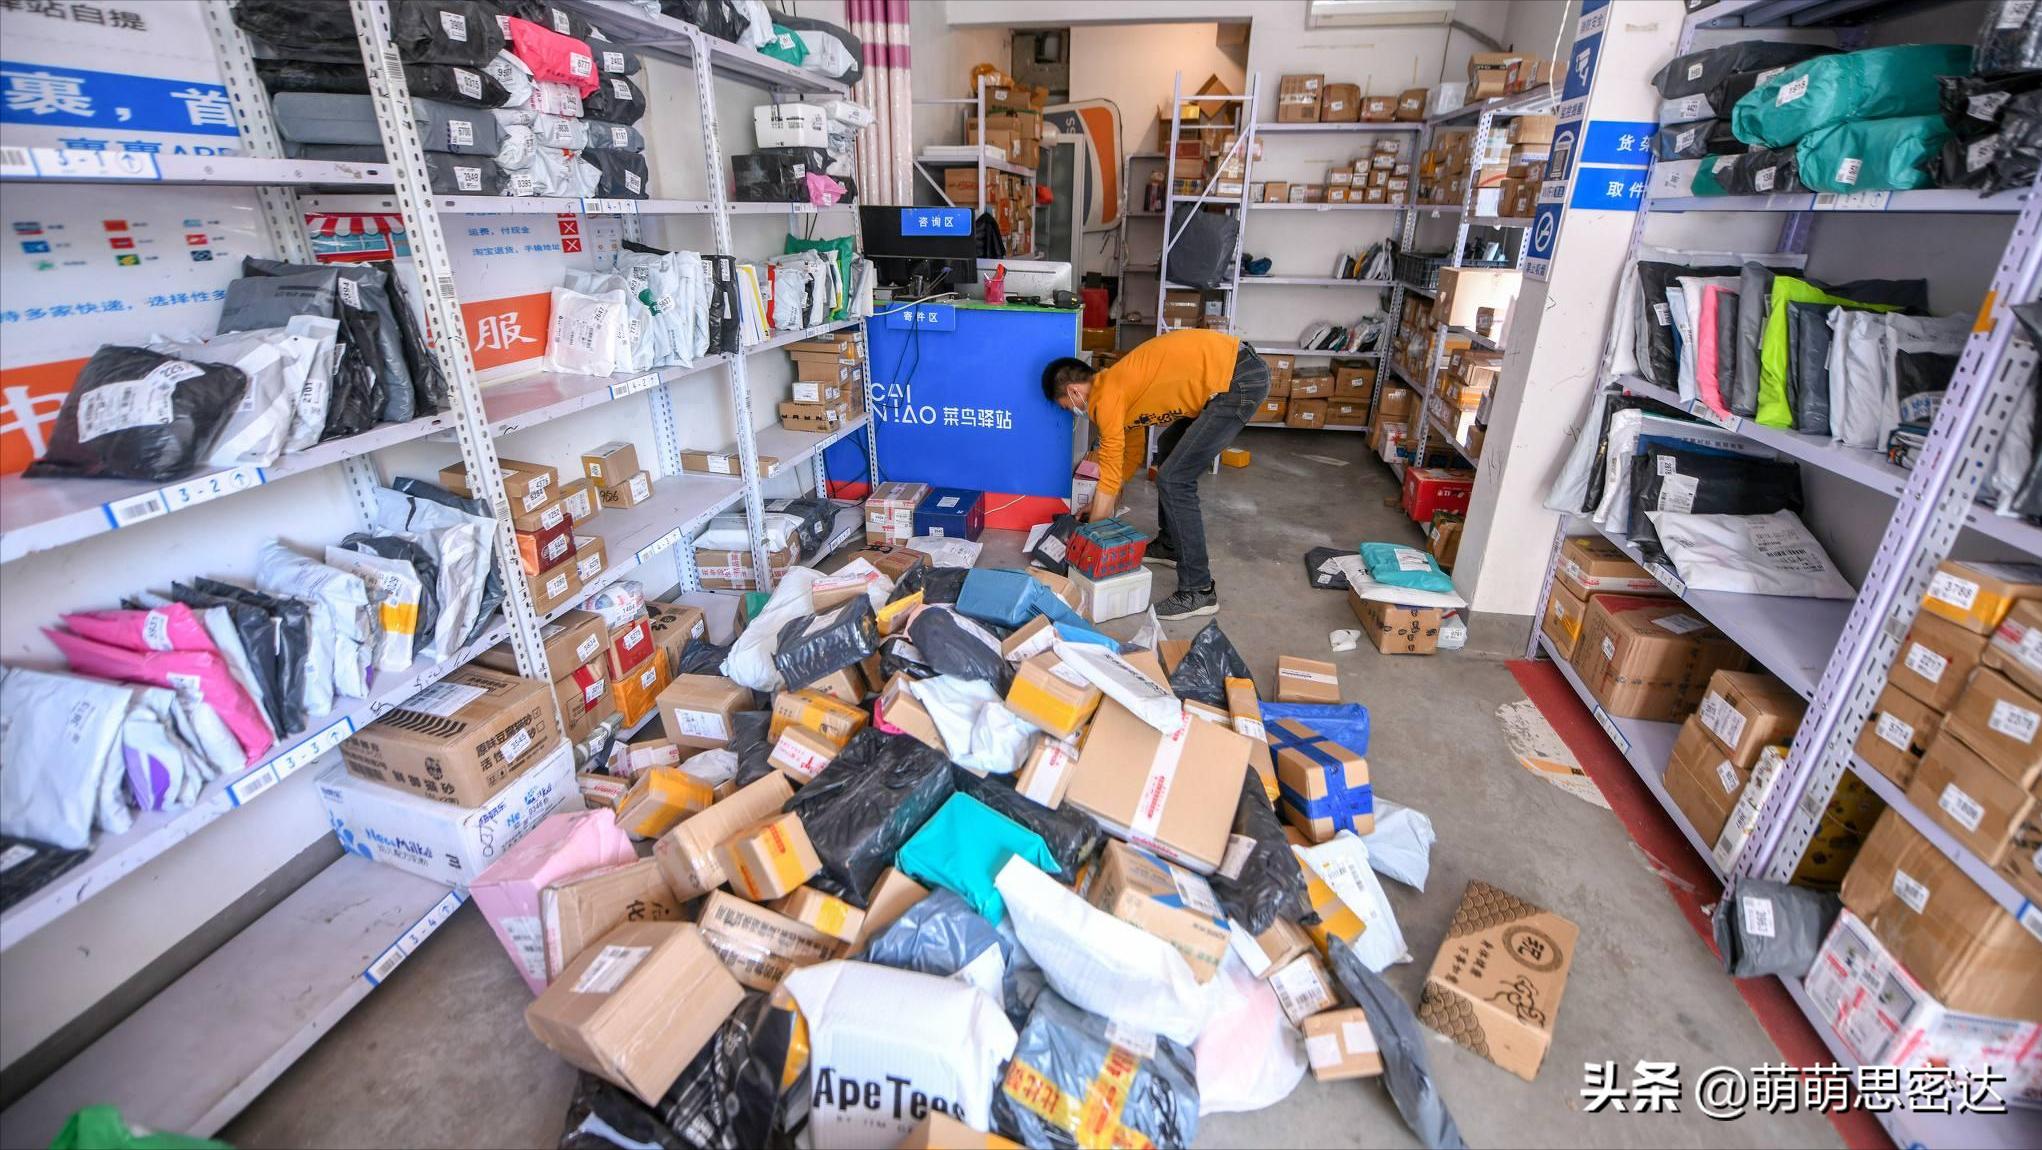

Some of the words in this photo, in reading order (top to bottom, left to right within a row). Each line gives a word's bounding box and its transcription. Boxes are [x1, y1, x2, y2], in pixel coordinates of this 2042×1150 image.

[918, 216, 955, 228] 咨询区
[474, 311, 538, 351] 服
[902, 311, 938, 323] 寄件区
[871, 383, 911, 403] CAI
[943, 407, 1012, 429] 菜鸟驿站
[178, 478, 222, 501] 3-2
[286, 741, 321, 770] 3-3
[480, 729, 538, 773] 活性砂
[409, 917, 438, 945] 3-4
[1470, 937, 1495, 981] 身体健康
[1517, 934, 1544, 962] 祝
